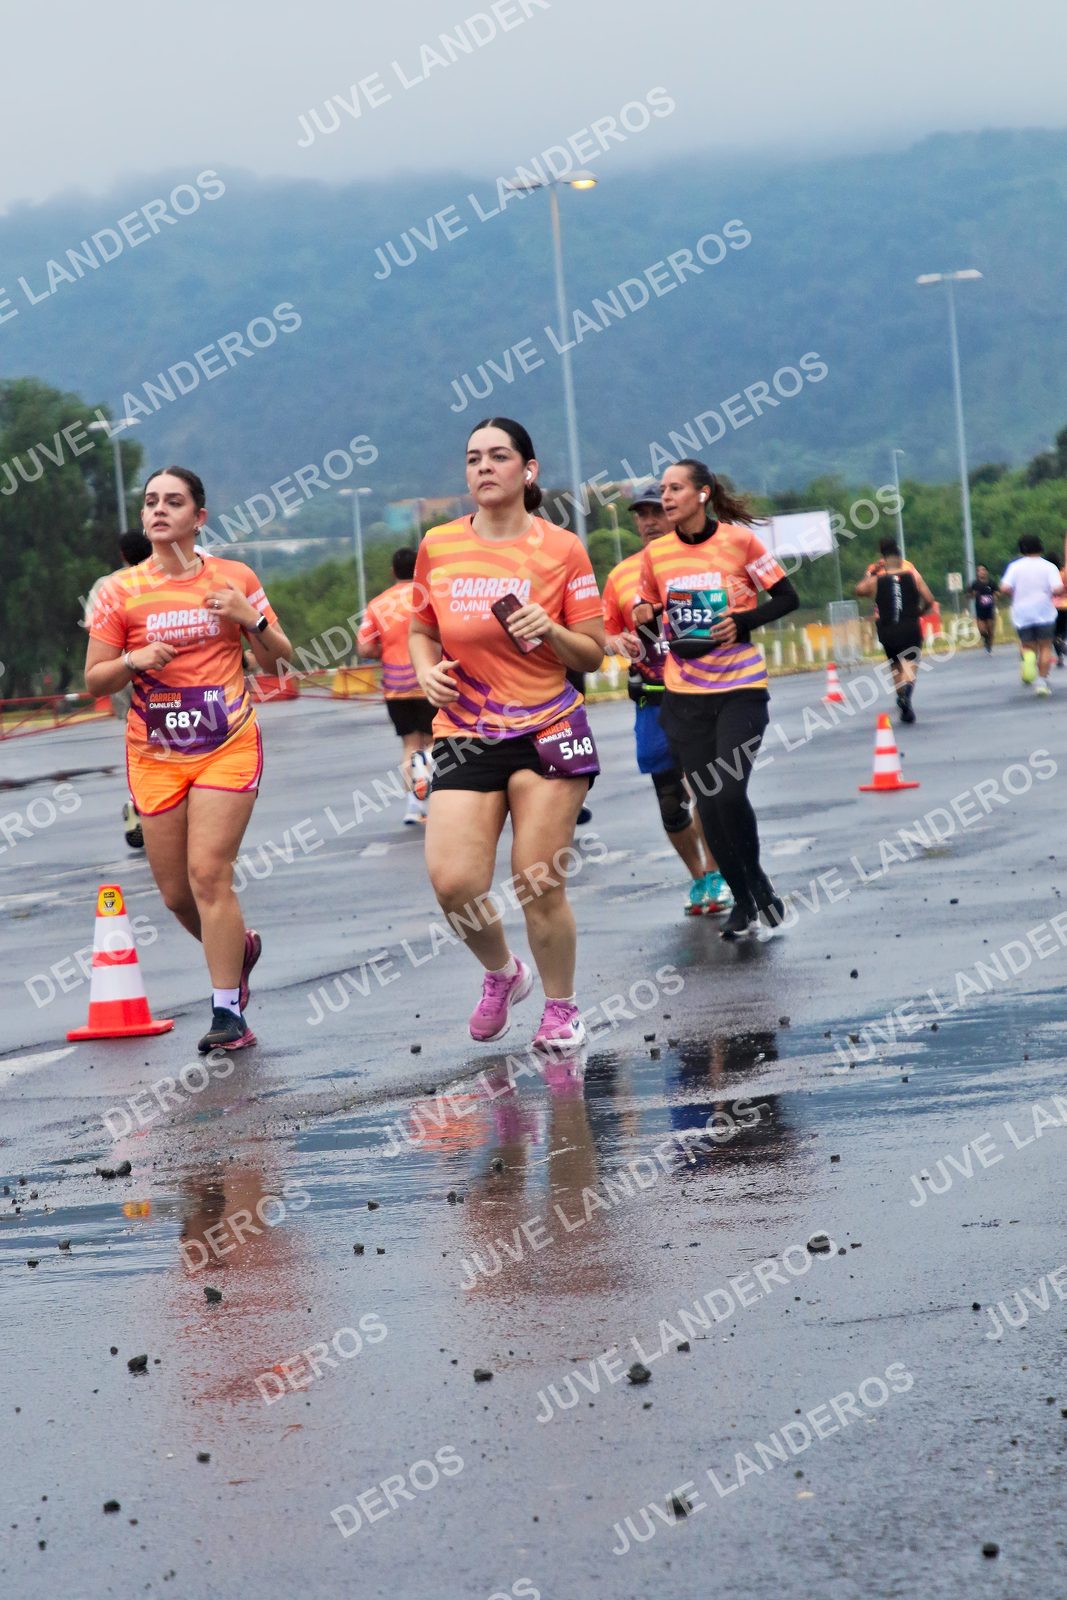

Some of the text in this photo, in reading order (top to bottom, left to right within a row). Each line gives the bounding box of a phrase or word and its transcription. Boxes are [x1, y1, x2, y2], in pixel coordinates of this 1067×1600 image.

[451, 578, 532, 598] CARRERA
[449, 600, 493, 612] OMNIL
[675, 608, 713, 623] 1352
[203, 690, 219, 702] 15K
[165, 711, 202, 729] 687
[559, 737, 594, 760] 548
